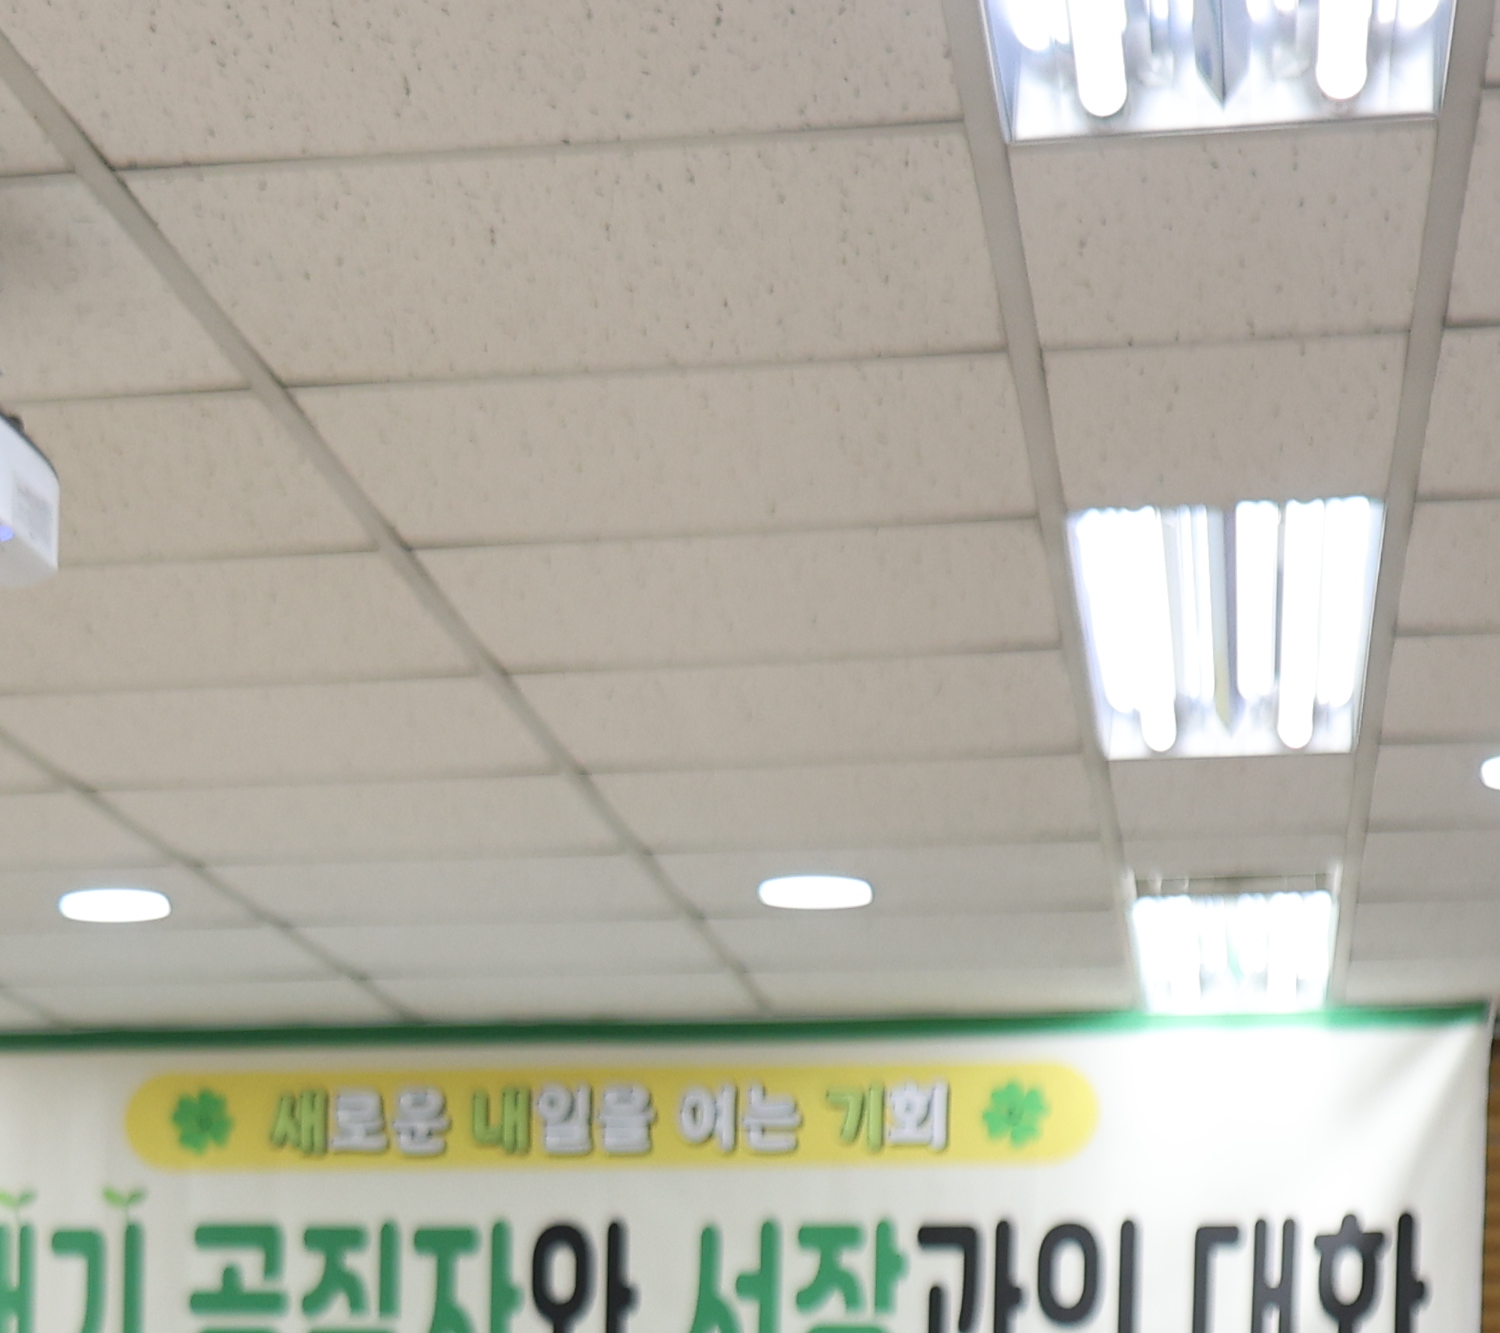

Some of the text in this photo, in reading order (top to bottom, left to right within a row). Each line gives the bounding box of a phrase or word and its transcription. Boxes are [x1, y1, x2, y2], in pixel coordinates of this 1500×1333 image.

[271, 1083, 949, 1155] 새로운 내일을 여는 기회
